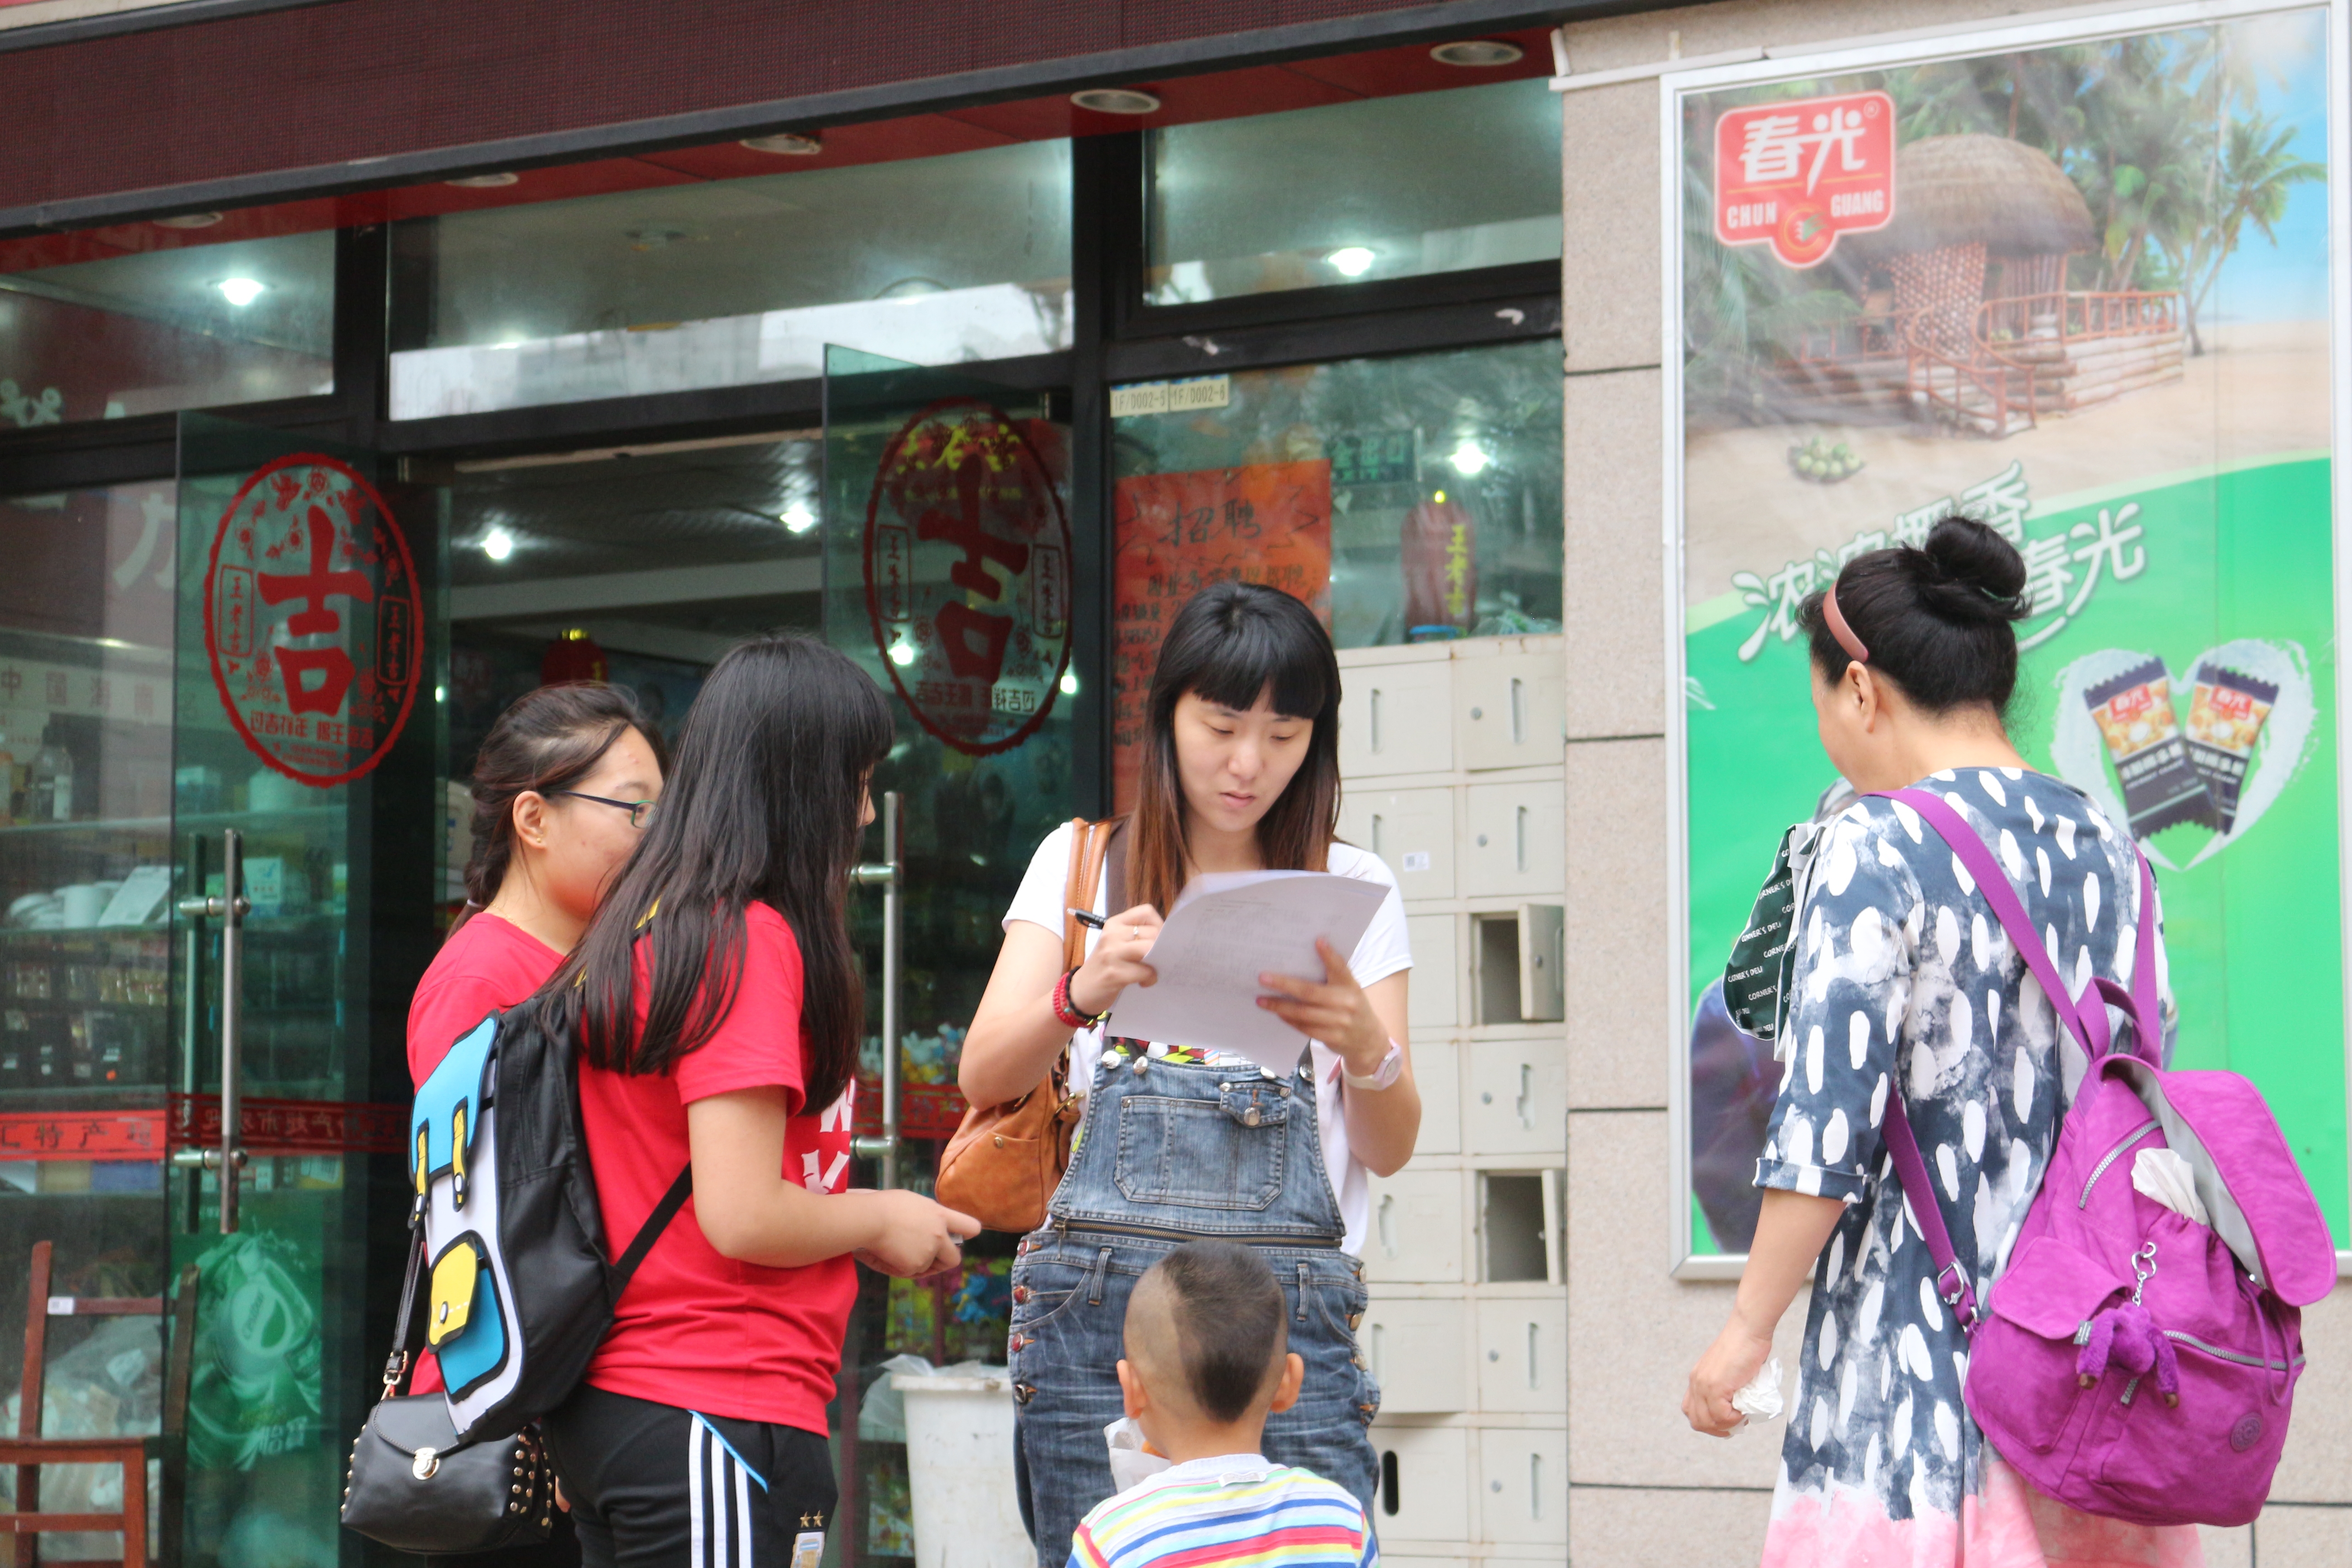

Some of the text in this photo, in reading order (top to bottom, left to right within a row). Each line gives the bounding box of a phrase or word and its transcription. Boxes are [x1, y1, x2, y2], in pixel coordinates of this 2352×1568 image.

[1738, 106, 1867, 197] 春光
[1726, 190, 1884, 227] CHUN GUANG
[1158, 500, 1262, 547] 招聘
[1731, 460, 2029, 663] 浓香
[257, 506, 374, 717] 吉
[1759, 882, 1785, 900] RNER'S
[1741, 921, 1782, 942] CORNER'S DELI
[1764, 943, 1787, 958] CORNE
[1728, 970, 1750, 983] CORNER'S
[1748, 985, 1777, 1001] CORNER'S
